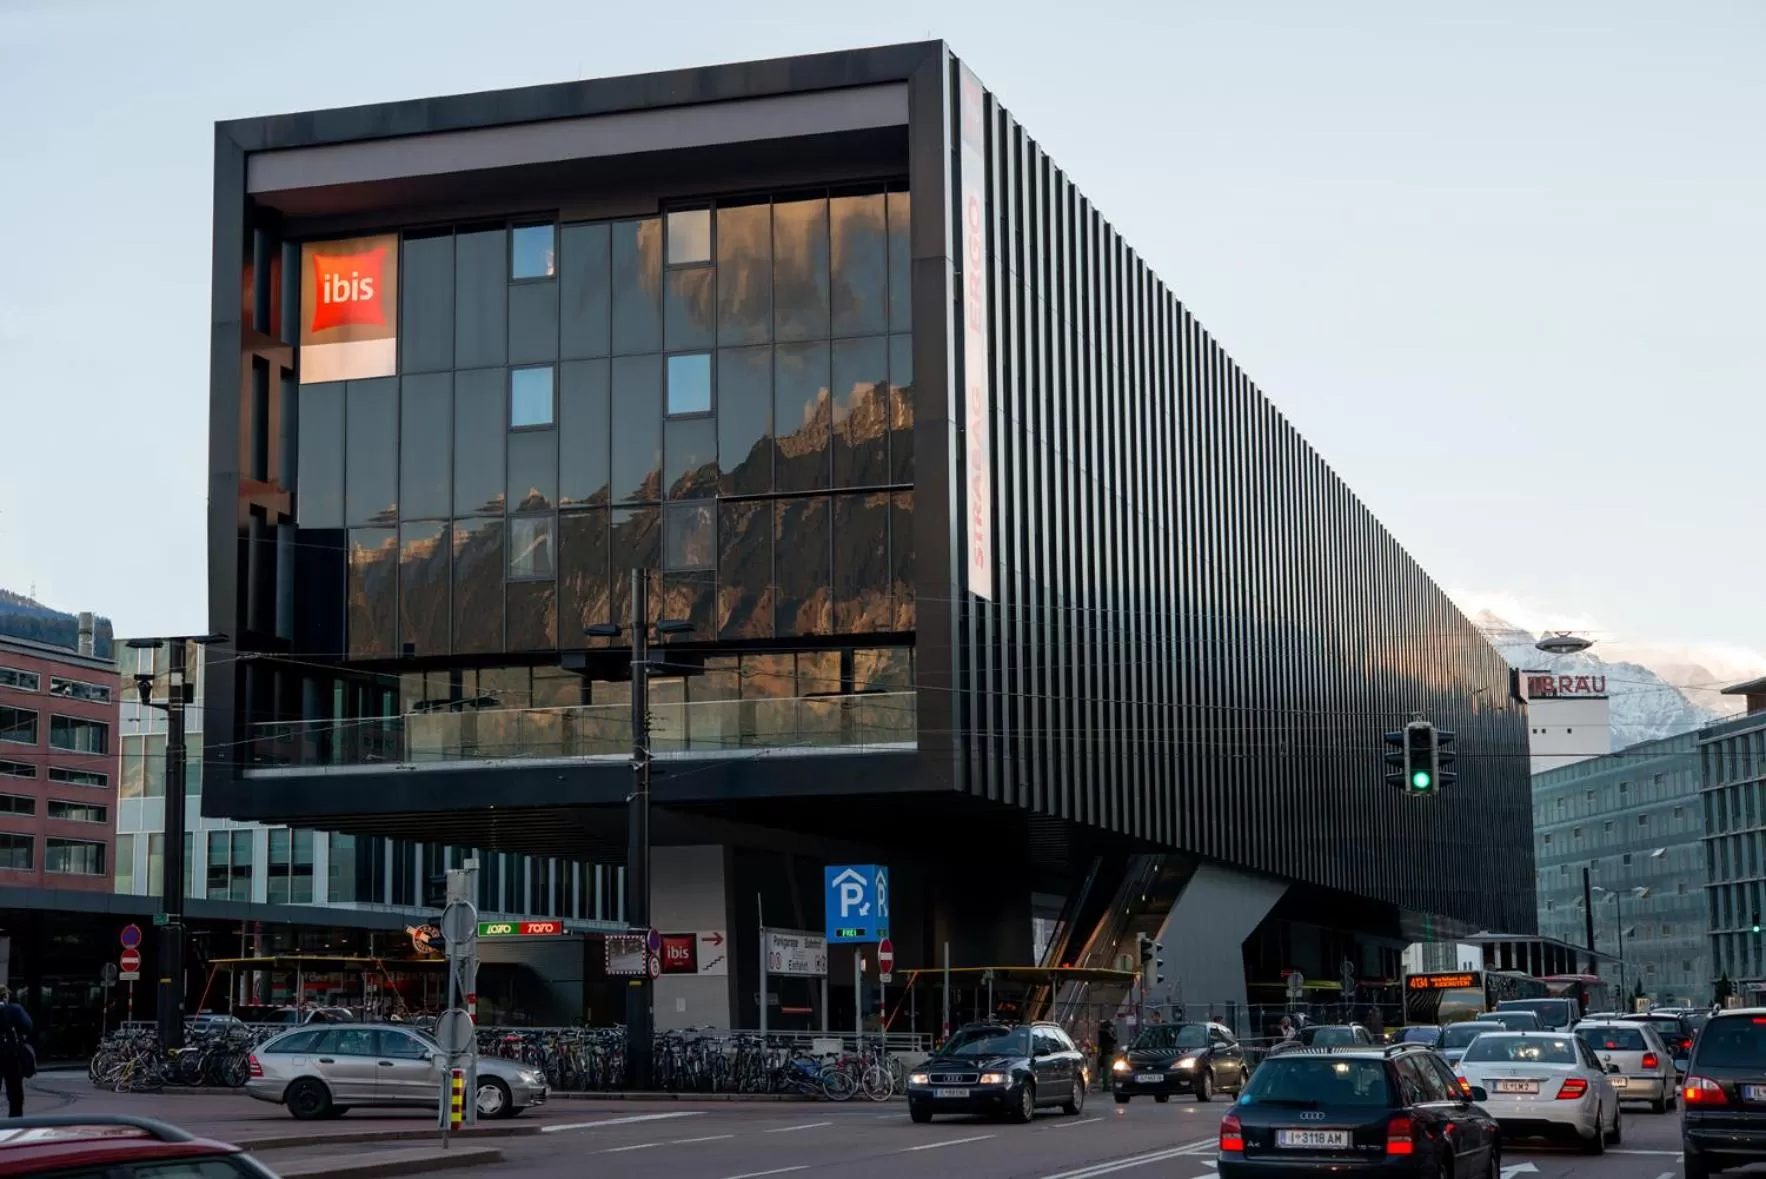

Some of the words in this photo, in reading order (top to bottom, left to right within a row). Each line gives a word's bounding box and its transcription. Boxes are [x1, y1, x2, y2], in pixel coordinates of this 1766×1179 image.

[968, 195, 982, 334] ERGO
[324, 271, 374, 304] ibis
[971, 386, 985, 570] STRABAG
[841, 883, 864, 918] P
[527, 923, 554, 934] TOTO
[667, 944, 690, 960] ibis
[1327, 1132, 1342, 1145] AM
